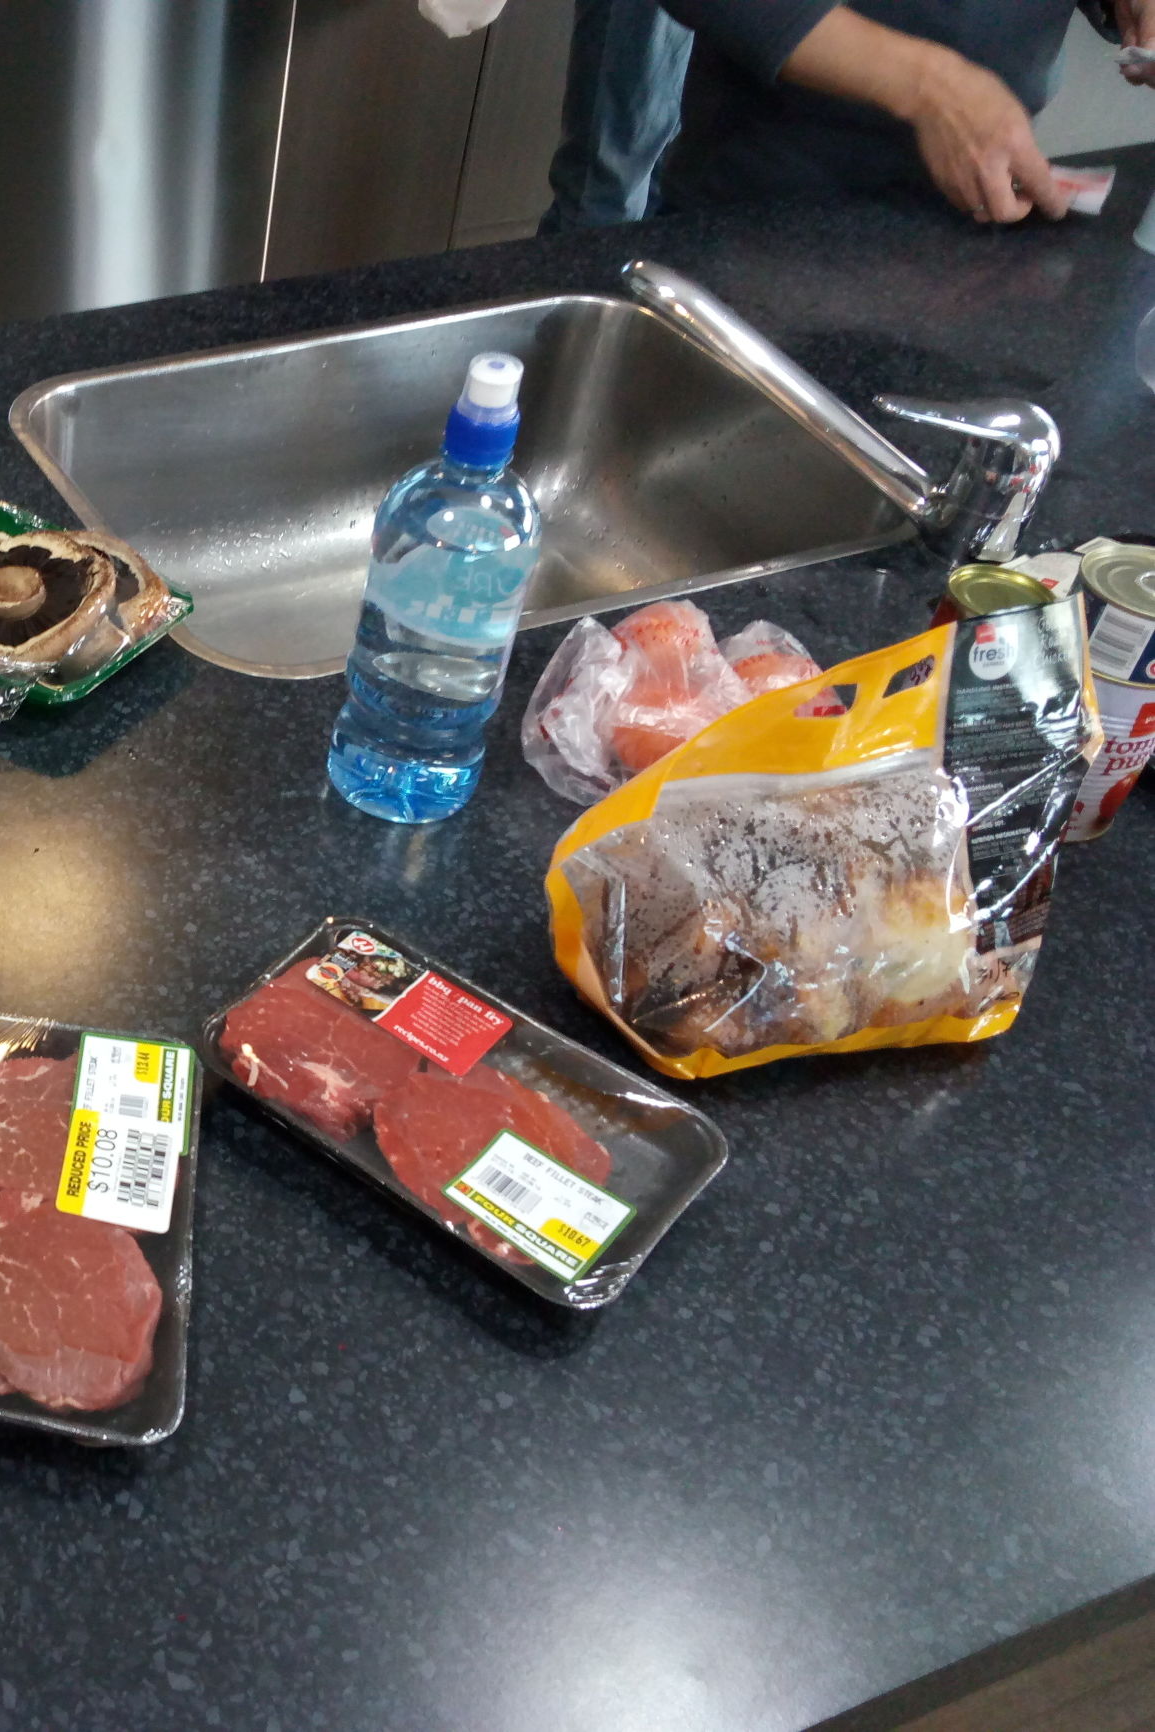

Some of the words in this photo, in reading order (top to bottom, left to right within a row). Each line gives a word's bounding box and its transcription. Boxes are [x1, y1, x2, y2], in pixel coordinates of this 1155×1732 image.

[973, 642, 1014, 662] fresh
[427, 976, 453, 997] bbq
[457, 995, 483, 1014] pan
[484, 1009, 504, 1027] fry
[163, 1051, 176, 1099] SQUARE
[76, 1121, 92, 1148] PRICE
[160, 1100, 172, 1123] OUR
[66, 1150, 88, 1198] REDUCED
[88, 1128, 118, 1194] $10.08
[522, 1152, 545, 1168] BEEF
[546, 1166, 576, 1190] FILLET
[577, 1184, 604, 1206] STEAK
[474, 1194, 515, 1227] FOUR
[512, 1223, 579, 1268] SQUARE
[557, 1223, 591, 1247] $10.67
